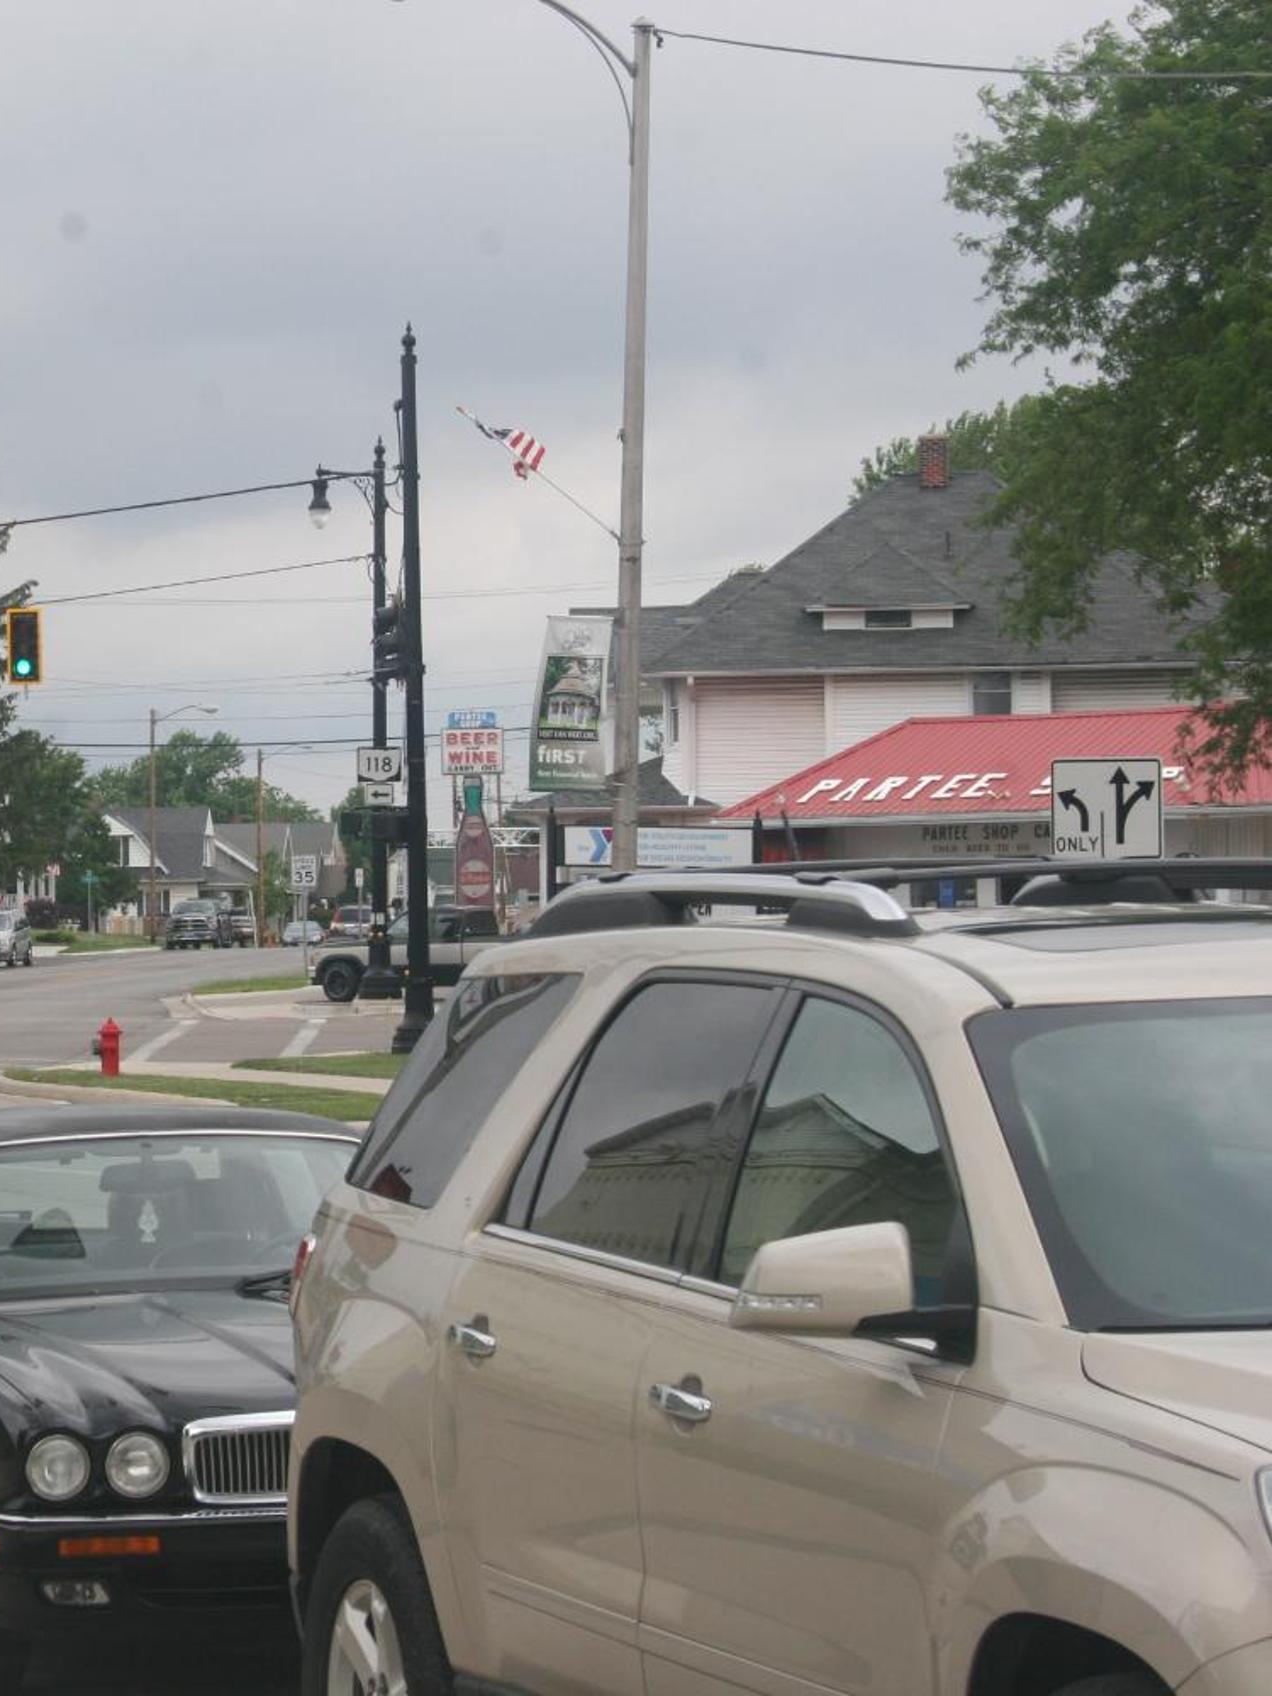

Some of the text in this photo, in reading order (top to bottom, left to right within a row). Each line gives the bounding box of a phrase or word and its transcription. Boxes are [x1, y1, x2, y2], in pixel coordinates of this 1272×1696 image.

[446, 732, 498, 745] BEER
[366, 757, 393, 772] 118
[448, 751, 497, 764] WINE
[796, 773, 1008, 803] PARTEE
[922, 825, 969, 841] PARTEE
[982, 824, 1020, 840] SHOP
[1056, 837, 1099, 853] ONLY
[294, 871, 314, 884] 35
